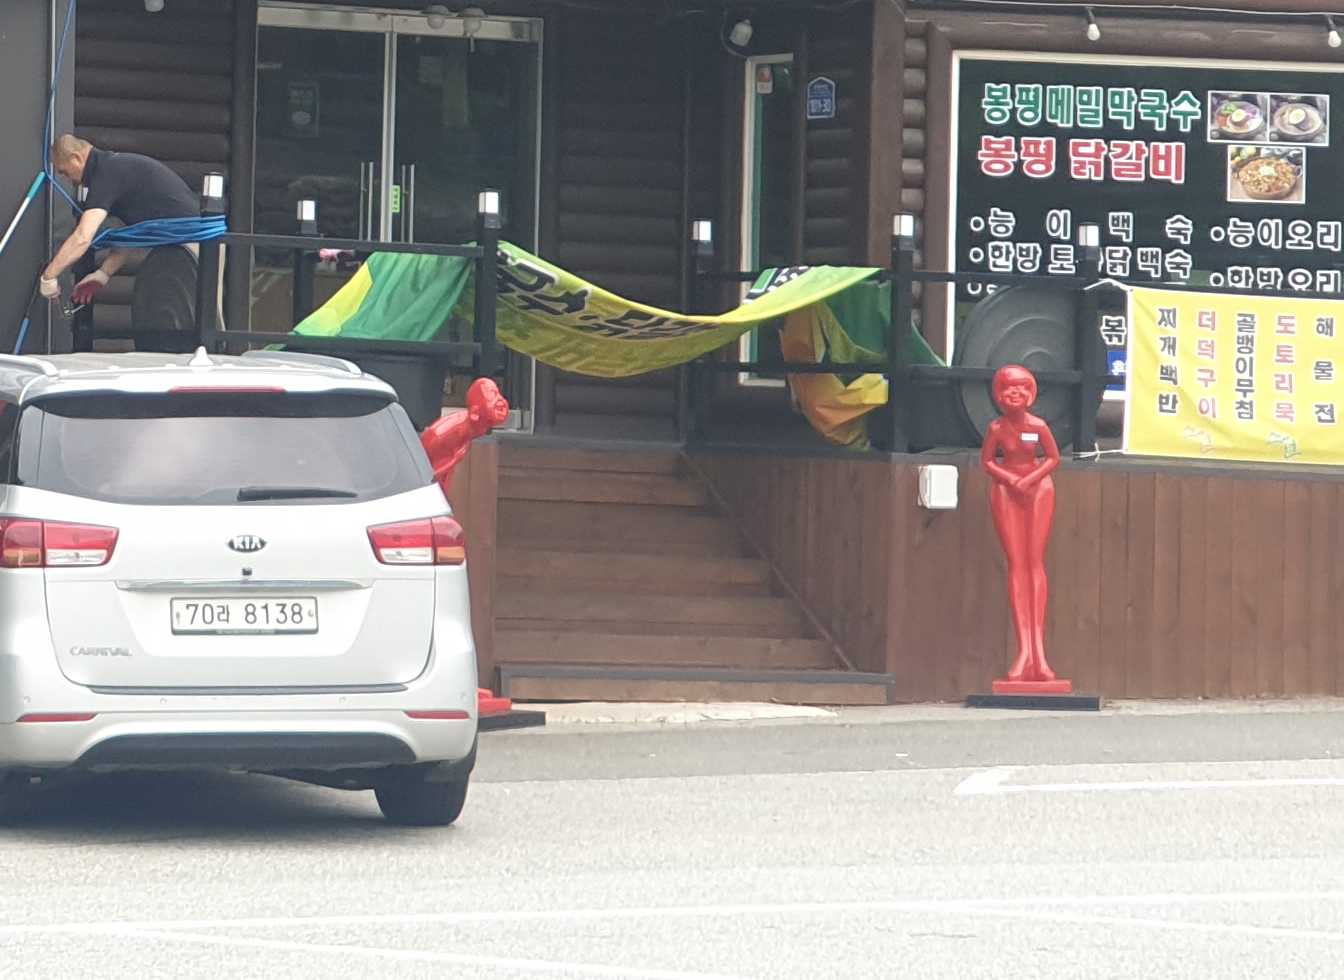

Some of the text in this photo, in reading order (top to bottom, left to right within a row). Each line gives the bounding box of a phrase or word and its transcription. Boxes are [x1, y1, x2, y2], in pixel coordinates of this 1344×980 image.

[982, 83, 1202, 132] 봉평메밀막국수
[977, 136, 1187, 184] 봉평 닭갈비
[1048, 243, 1131, 277] 토닭
[1158, 307, 1178, 414] 찌개백반
[1197, 311, 1216, 419] 더덕구이
[1235, 313, 1256, 420] 골뱅이무침
[1274, 316, 1296, 422] 도토리묵
[1314, 317, 1336, 424] 해물전
[231, 535, 264, 552] KIA
[186, 602, 304, 625] 70라 8138
[69, 646, 133, 657] CARNIVAL
